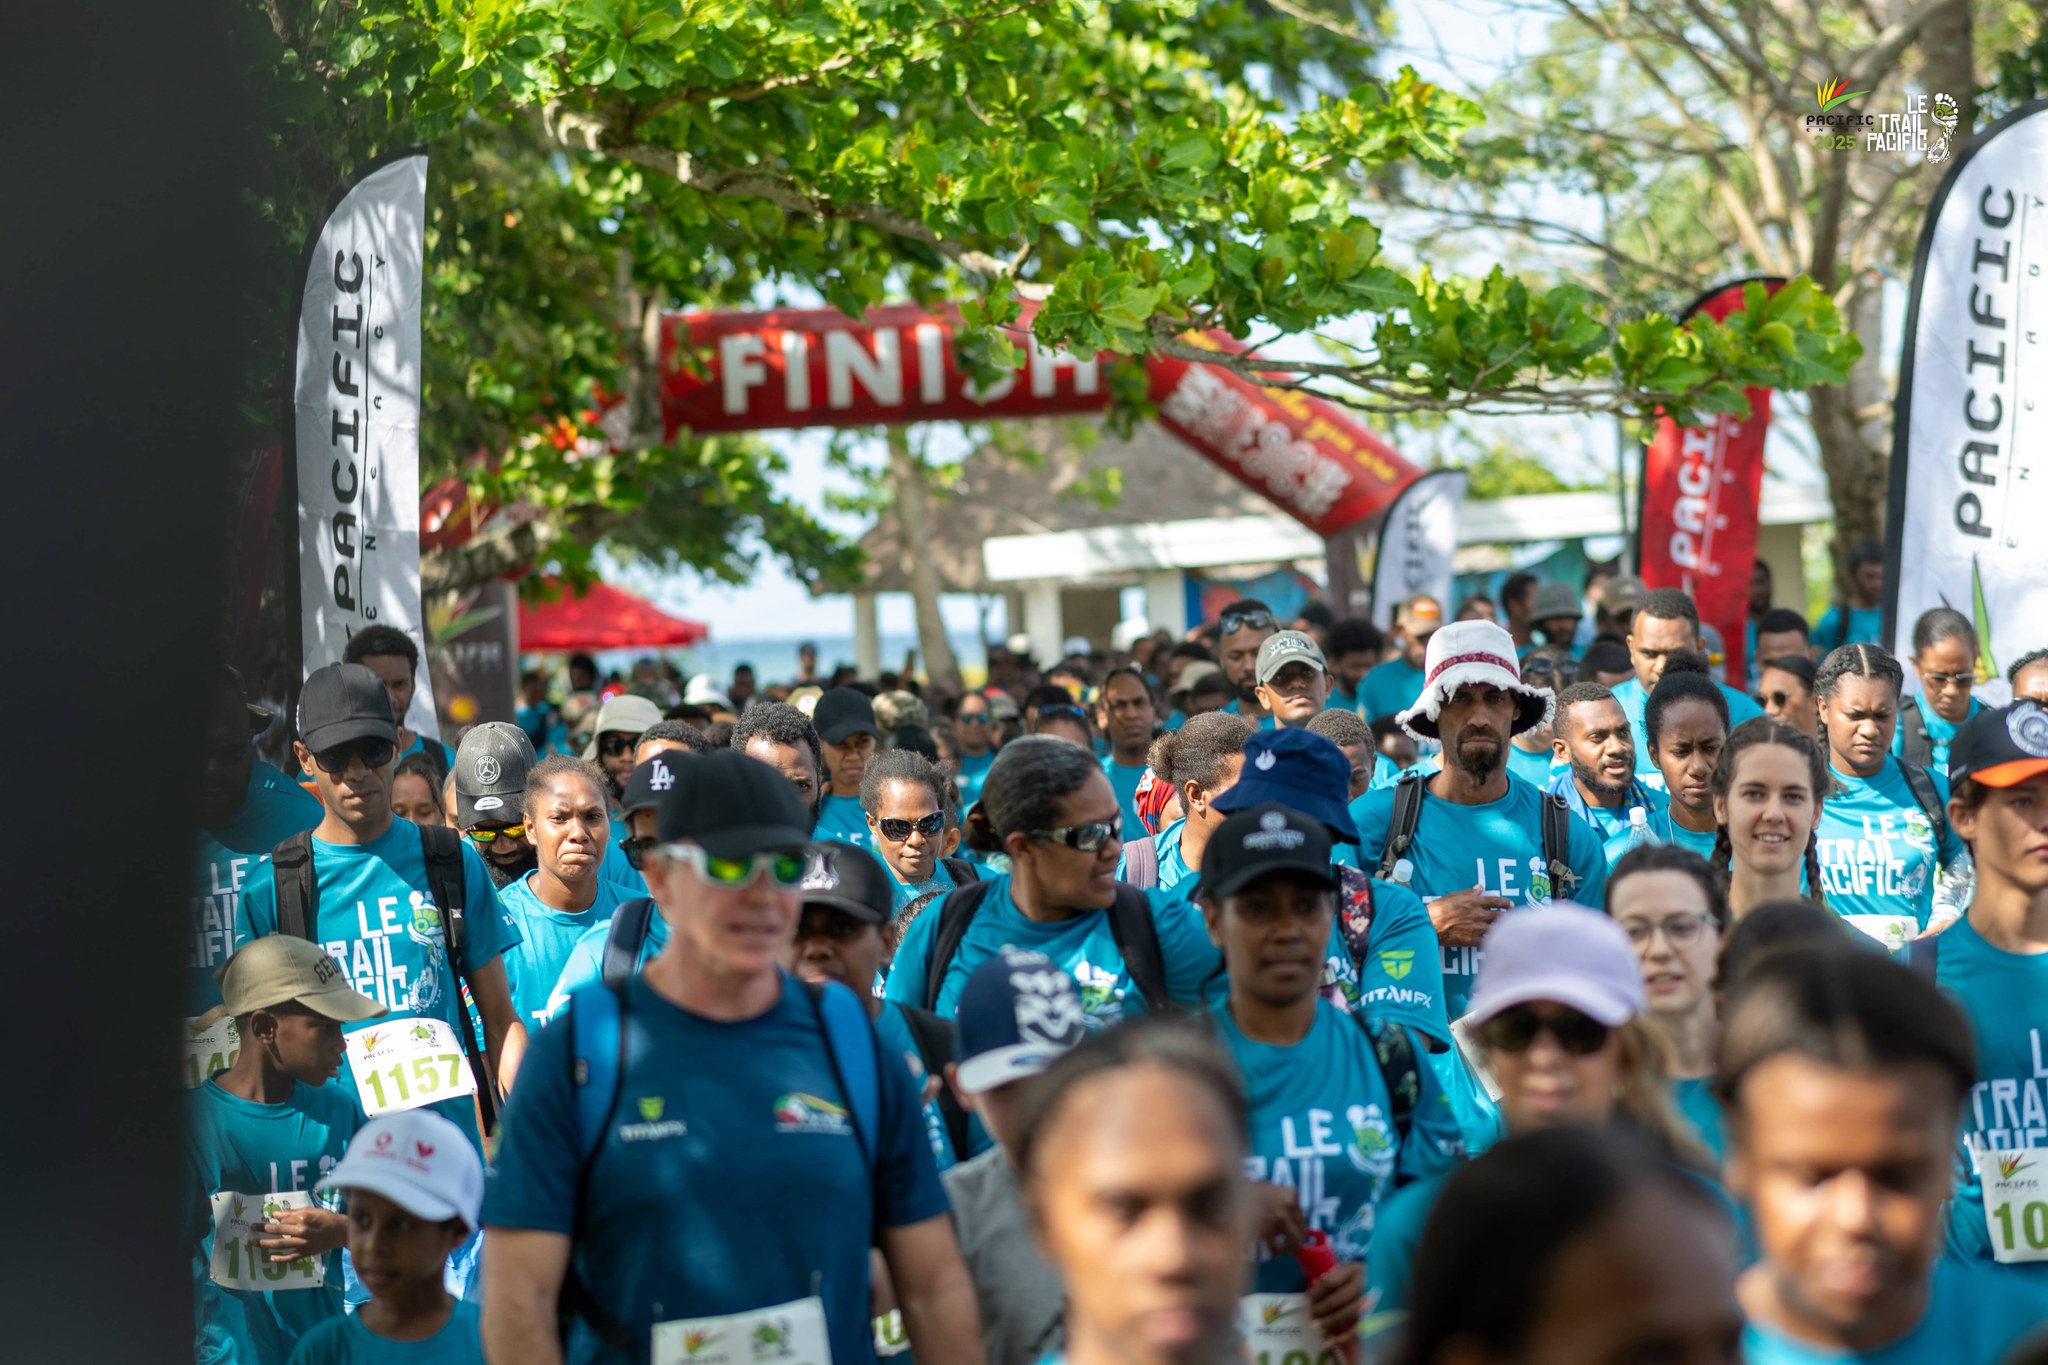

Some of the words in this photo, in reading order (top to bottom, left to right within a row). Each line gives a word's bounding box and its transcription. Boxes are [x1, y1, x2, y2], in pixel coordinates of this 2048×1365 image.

[1954, 184, 2015, 538] PACIFIC
[332, 250, 364, 612] PACIFIC
[650, 760, 676, 791] LA
[1862, 814, 1901, 840] LE
[1817, 838, 1906, 867] TRAIL
[211, 858, 248, 895] LE
[1477, 858, 1520, 896] LE
[357, 896, 403, 939] LE
[318, 936, 408, 979] RAIL
[1360, 985, 1433, 1009] TITANFX
[365, 1053, 460, 1108] 1157
[1281, 1108, 1342, 1158] LE
